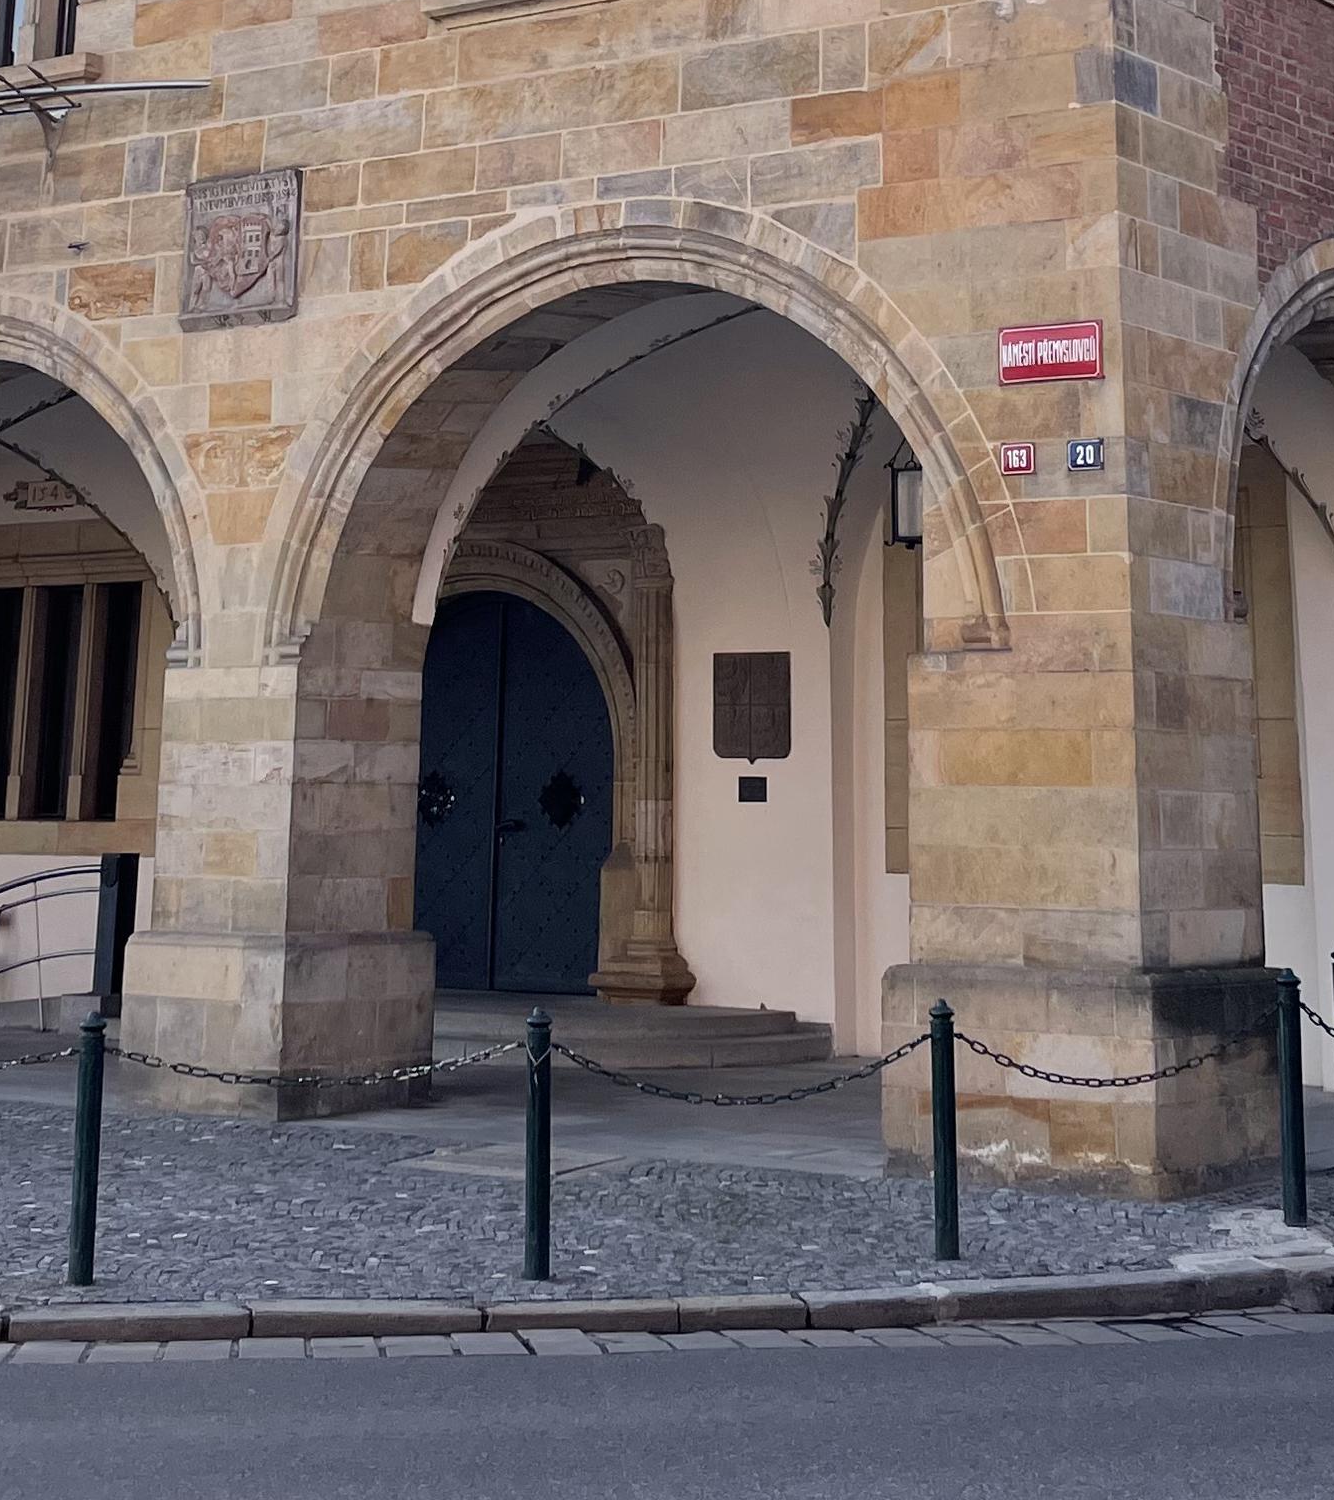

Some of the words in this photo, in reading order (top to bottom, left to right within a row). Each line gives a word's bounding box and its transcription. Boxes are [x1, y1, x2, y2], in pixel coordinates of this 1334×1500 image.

[1002, 340, 1036, 368] NÁMĚSTÍ
[1037, 335, 1096, 365] PŘEMYSLOVCŮ
[1006, 449, 1027, 468] 163
[1076, 445, 1095, 465] 20
